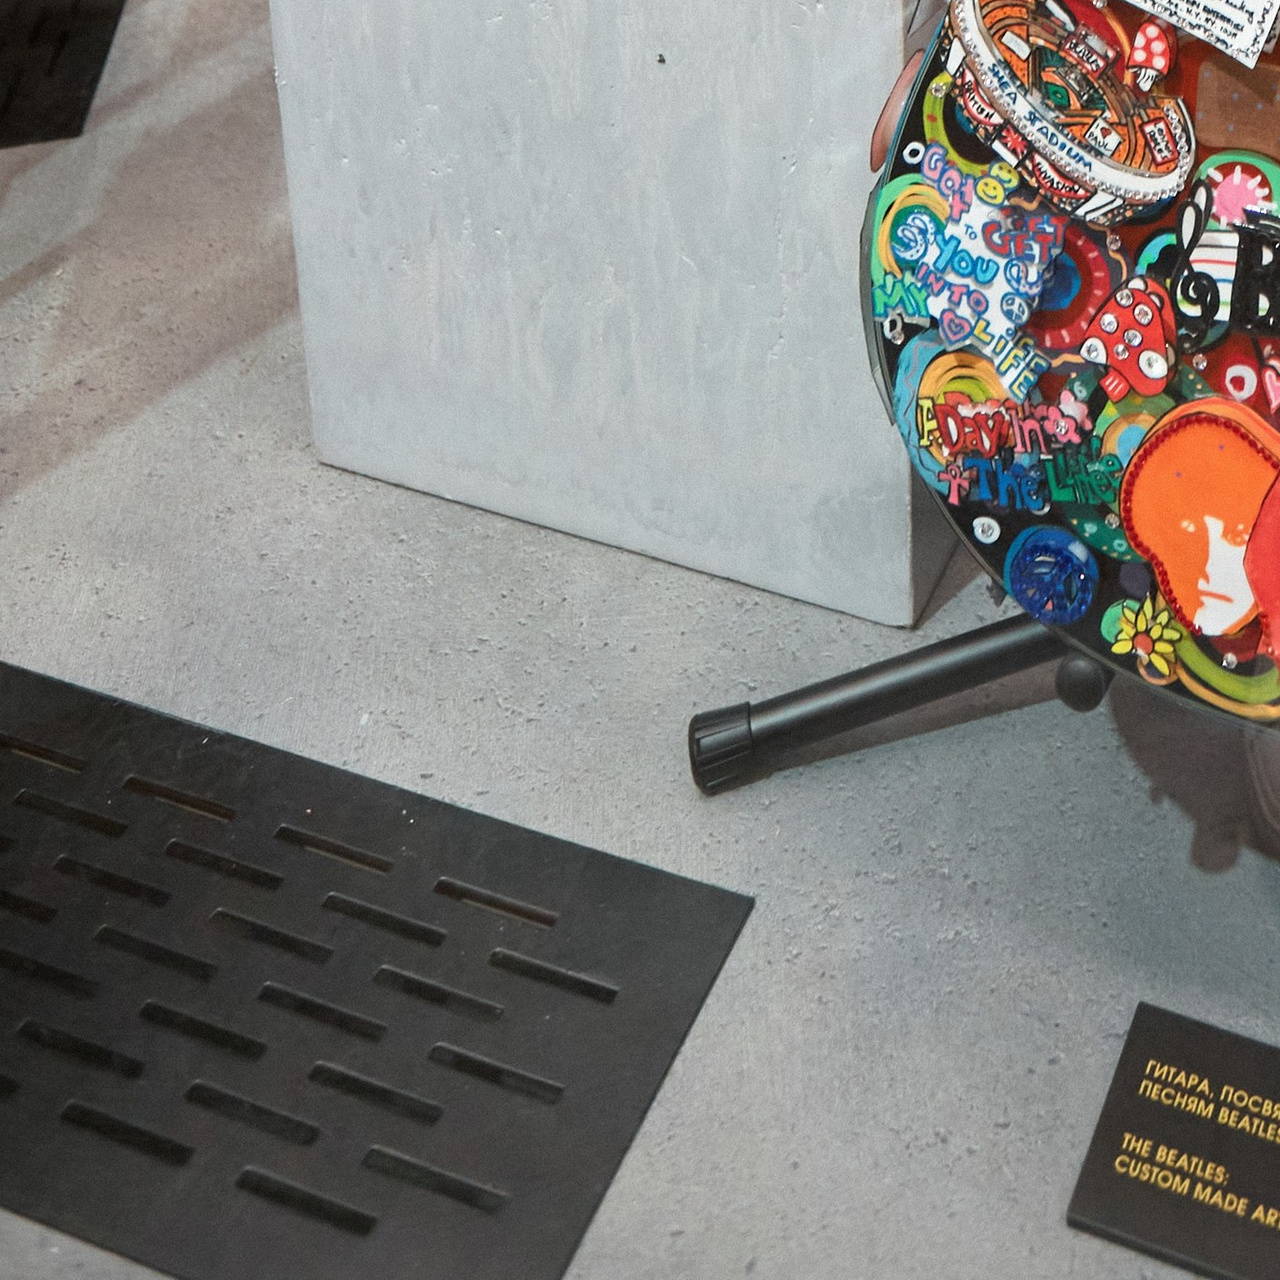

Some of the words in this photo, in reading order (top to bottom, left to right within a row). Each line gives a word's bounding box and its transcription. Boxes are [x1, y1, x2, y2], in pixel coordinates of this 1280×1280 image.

[987, 63, 1018, 105] SHEA
[1024, 110, 1093, 173] STADIUM
[1088, 132, 1113, 151] PAUL
[934, 236, 1000, 285] YOU
[873, 278, 930, 318] MY
[915, 263, 989, 315] INTO
[917, 397, 938, 447] A
[935, 403, 1008, 459] Day
[962, 457, 1045, 510] The
[1138, 1078, 1214, 1120] ПЕСНЯМ
[1144, 1058, 1215, 1100] ГИТАРА,
[1122, 1132, 1153, 1158] THE
[1113, 1154, 1191, 1197] CUSTOM
[1193, 1180, 1248, 1217] MADE
